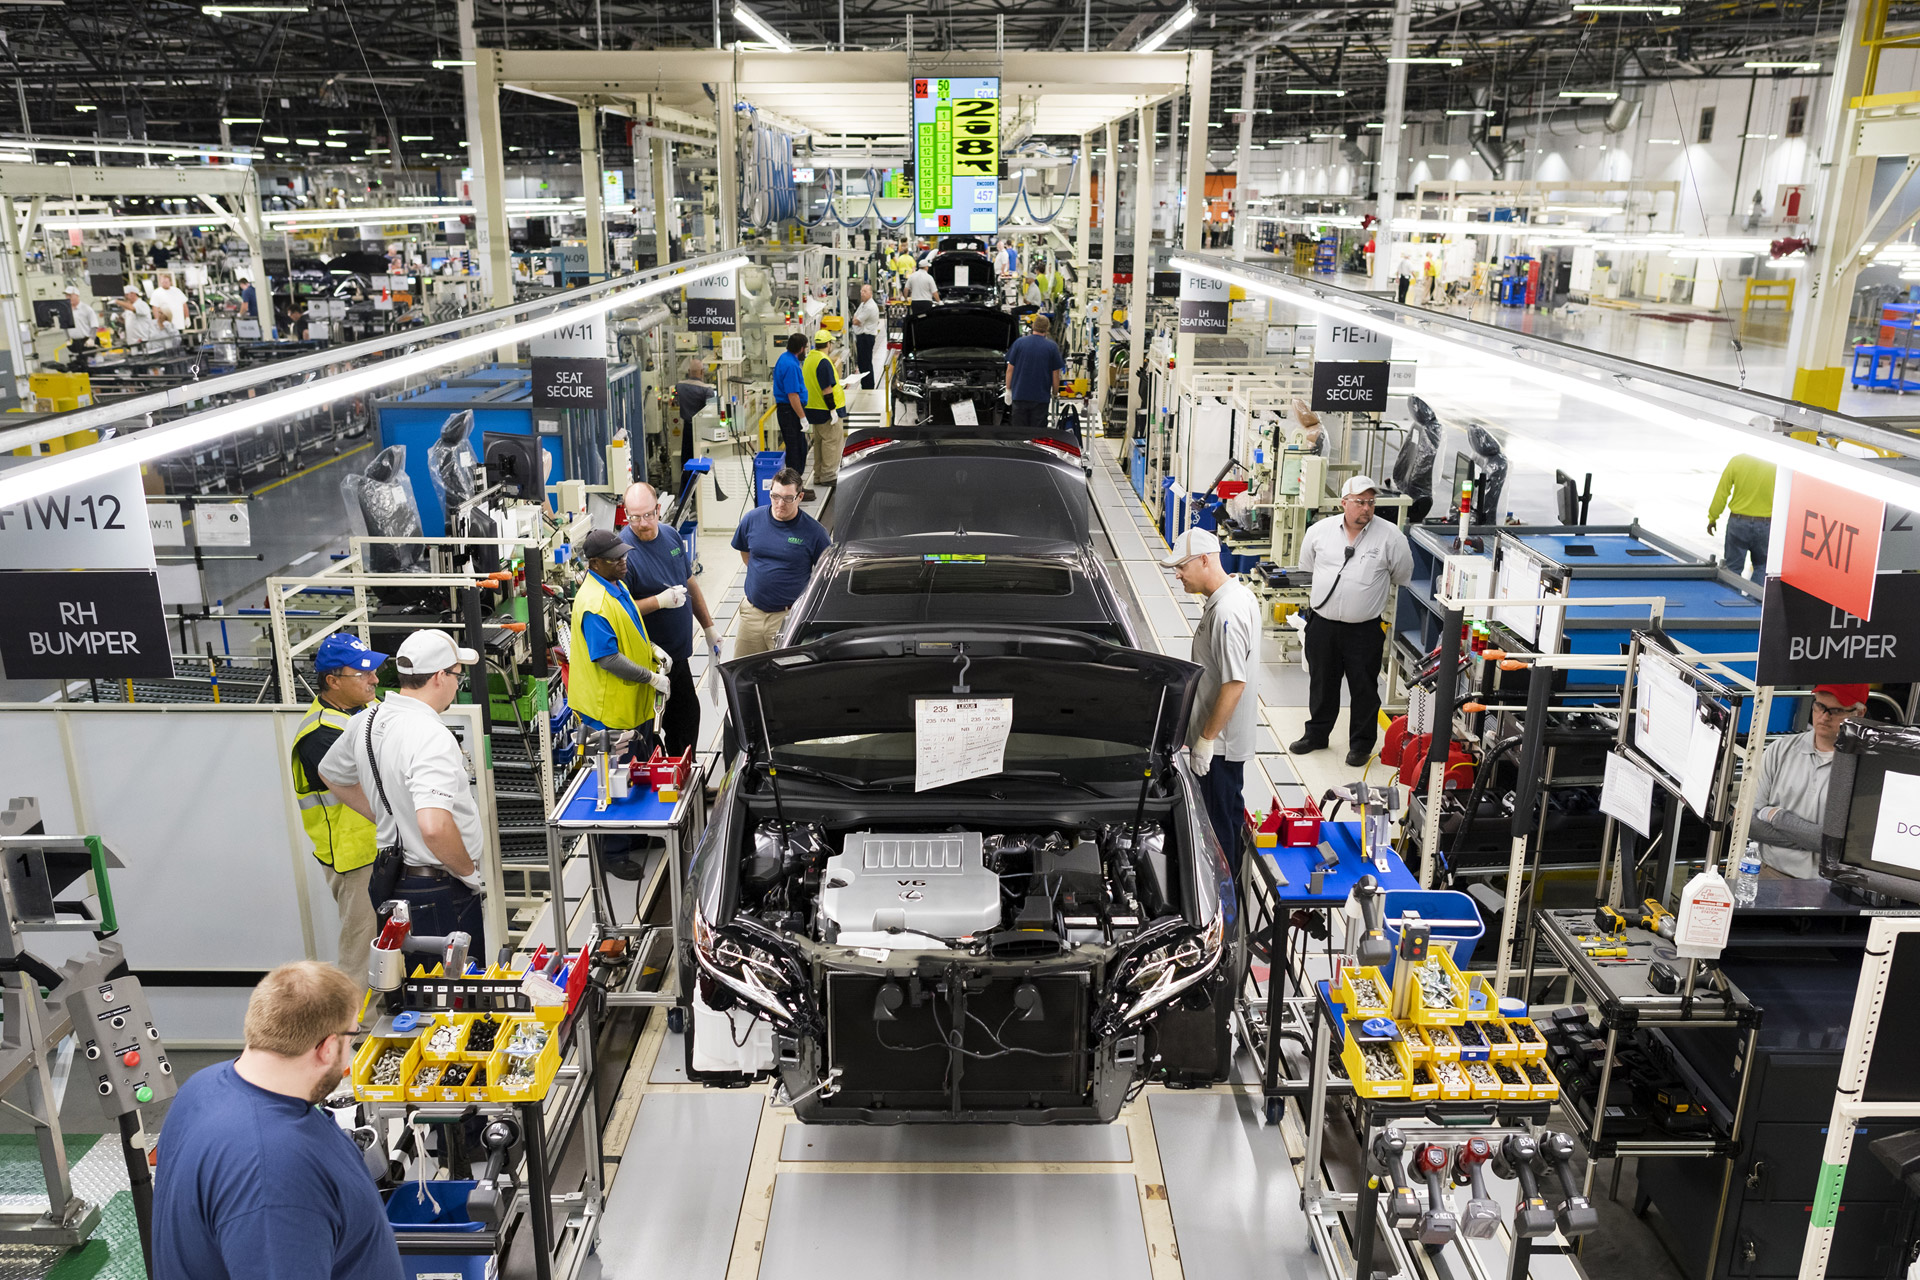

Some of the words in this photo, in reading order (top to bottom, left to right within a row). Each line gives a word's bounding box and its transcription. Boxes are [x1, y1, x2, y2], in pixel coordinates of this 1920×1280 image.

[938, 80, 950, 91] 50
[976, 191, 993, 201] 457
[942, 215, 948, 225] 9
[554, 254, 585, 263] FW-09
[1190, 278, 1222, 290] F1E-10
[688, 316, 707, 324] SEAT
[707, 317, 735, 325] INSTALL
[1180, 318, 1198, 326] SEAT
[1199, 318, 1226, 327] INSTALL
[1332, 327, 1377, 343] F1E-11
[556, 372, 583, 384] SEAT
[1337, 375, 1365, 386] SEAT
[547, 386, 593, 398] SECURE
[1326, 389, 1374, 401] SECURE
[149, 519, 173, 529] 1W-11
[1800, 509, 1860, 574] EXIT
[58, 601, 98, 625] RH
[1830, 606, 1862, 629] LH
[29, 631, 141, 655] BUMPER
[1789, 635, 1897, 660] BUMPER
[17, 853, 31, 877] 1
[1519, 1137, 1535, 1147] BSM
